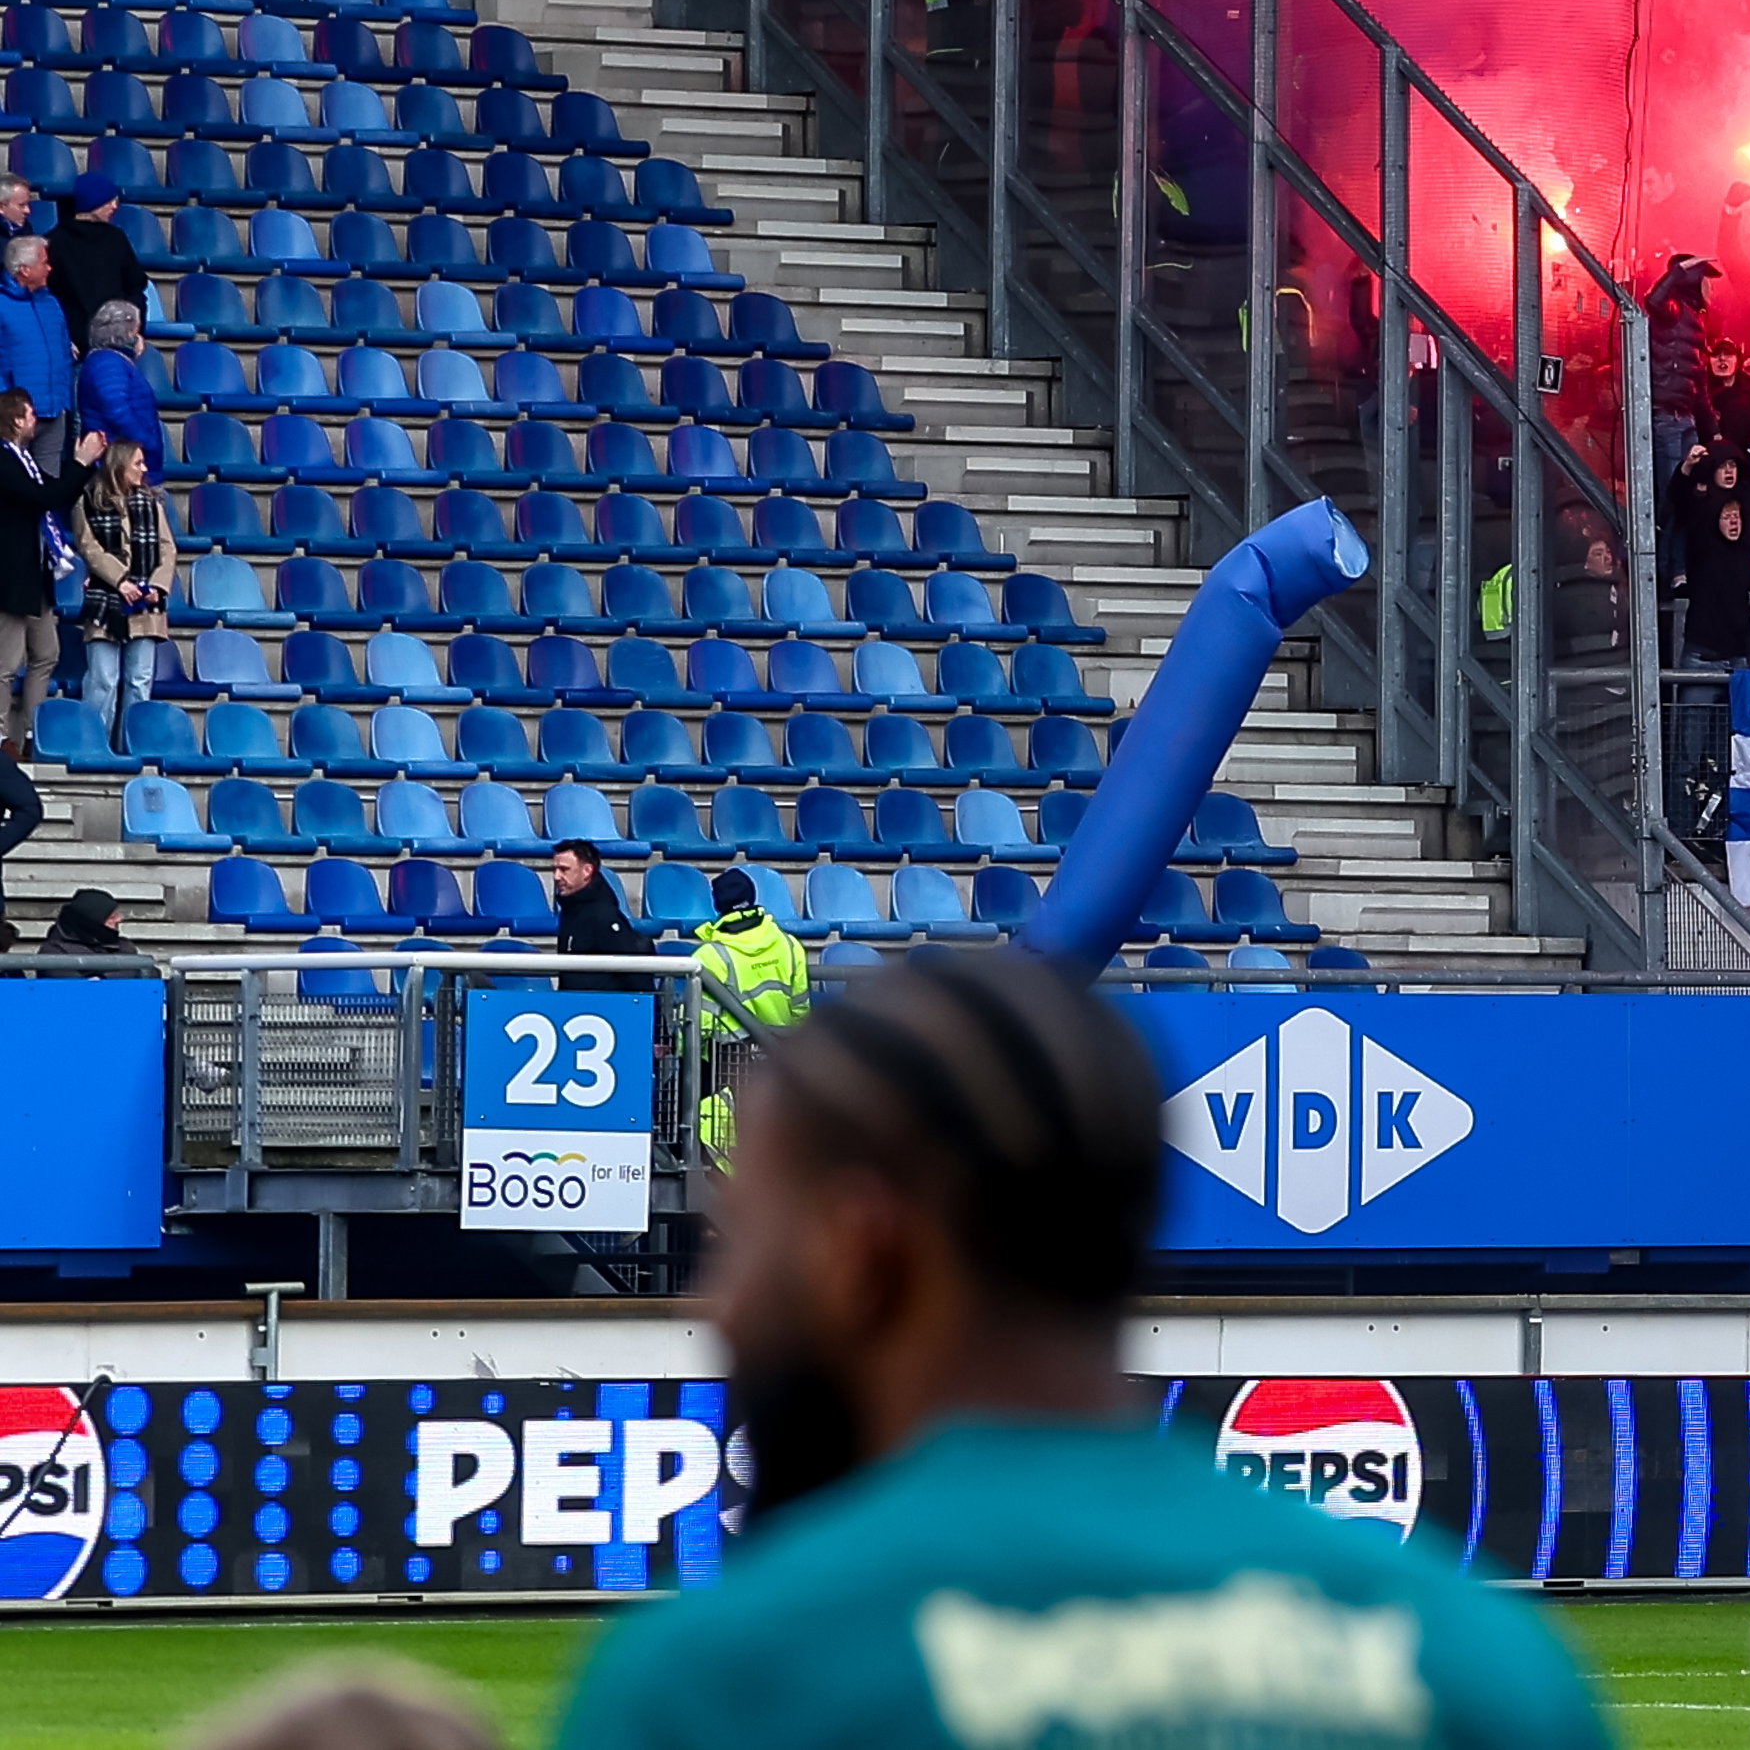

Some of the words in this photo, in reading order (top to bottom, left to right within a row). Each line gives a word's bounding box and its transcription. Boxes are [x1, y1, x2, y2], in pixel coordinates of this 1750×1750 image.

[504, 1013, 618, 1108] 23
[1204, 1091, 1423, 1150] VDK
[591, 1162, 613, 1183] for
[619, 1162, 646, 1184] life!
[0, 1462, 90, 1516] PSI
